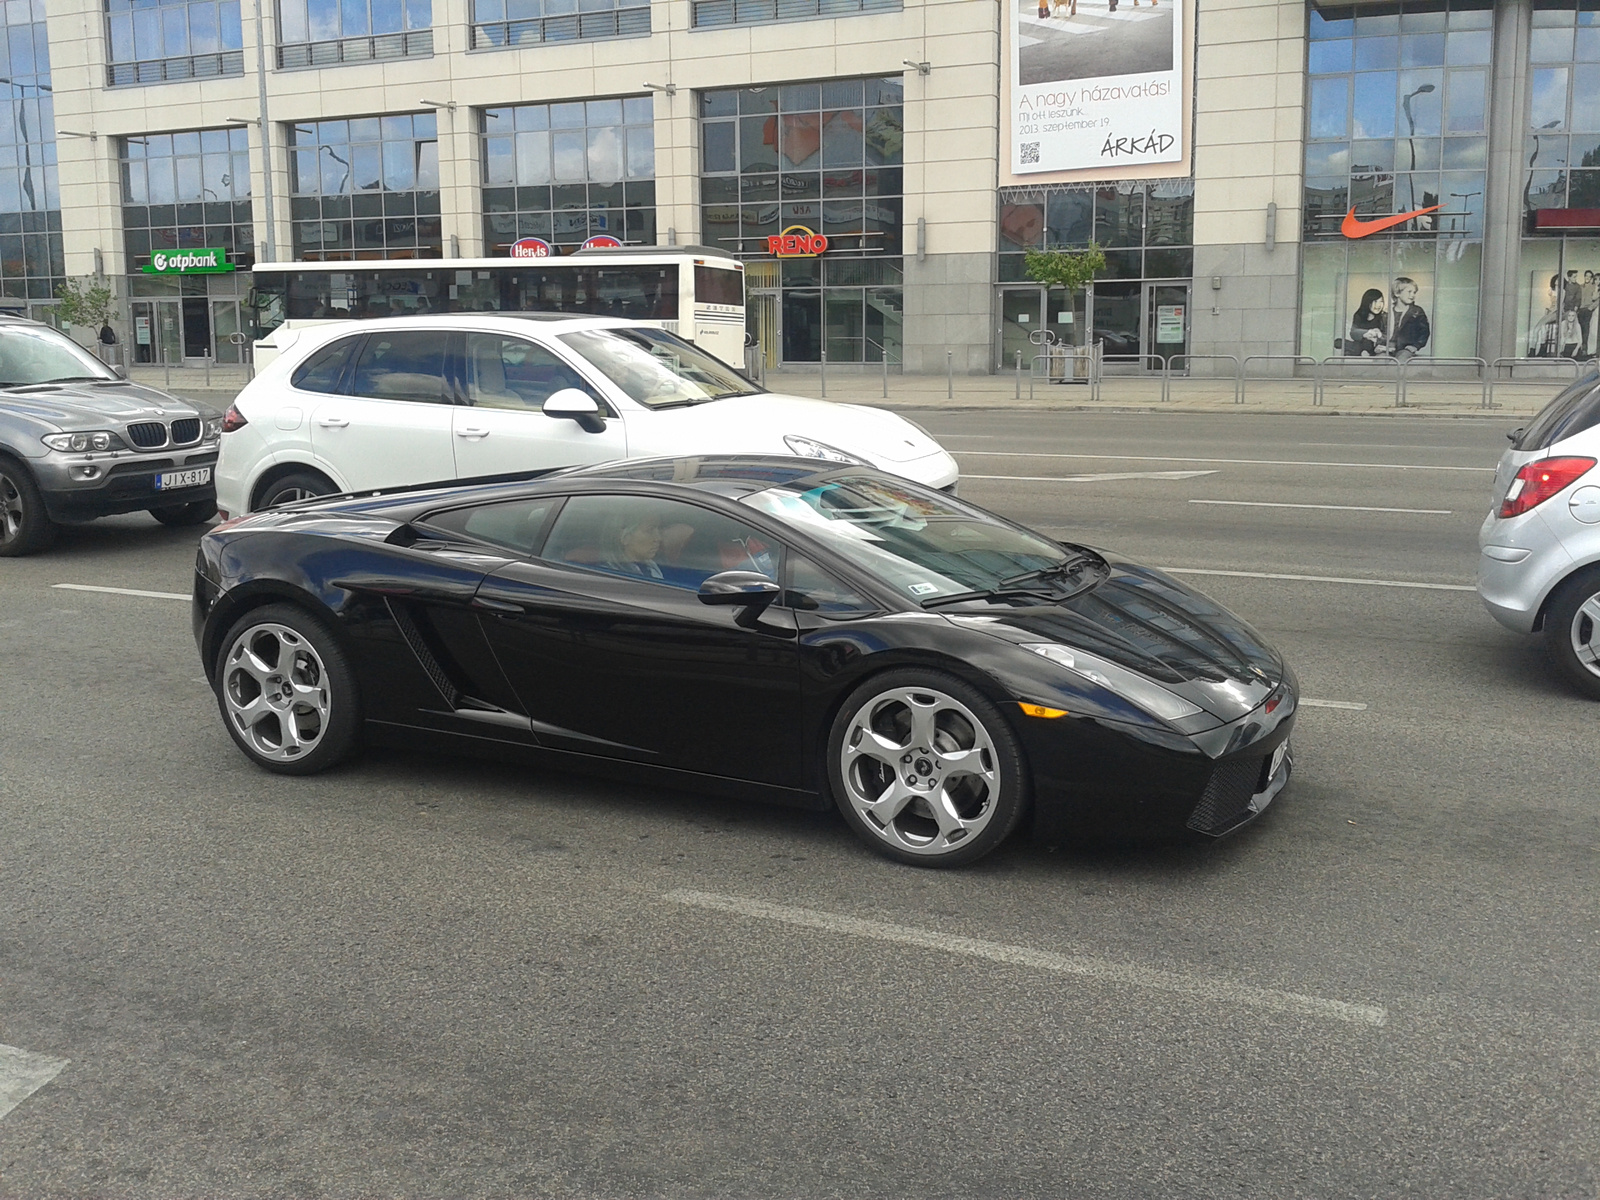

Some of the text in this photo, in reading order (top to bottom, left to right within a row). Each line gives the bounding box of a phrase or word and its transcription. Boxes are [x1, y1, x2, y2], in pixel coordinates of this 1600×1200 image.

[1019, 80, 1171, 110] A nagy házavatás!
[1031, 110, 1046, 121] ott
[1042, 119, 1098, 132] szeptember
[1101, 128, 1175, 158] ÁRKÁD
[515, 244, 547, 258] Hervis
[767, 234, 828, 255] RENO
[168, 251, 218, 272] otpbank
[164, 469, 209, 487] JIX-817
